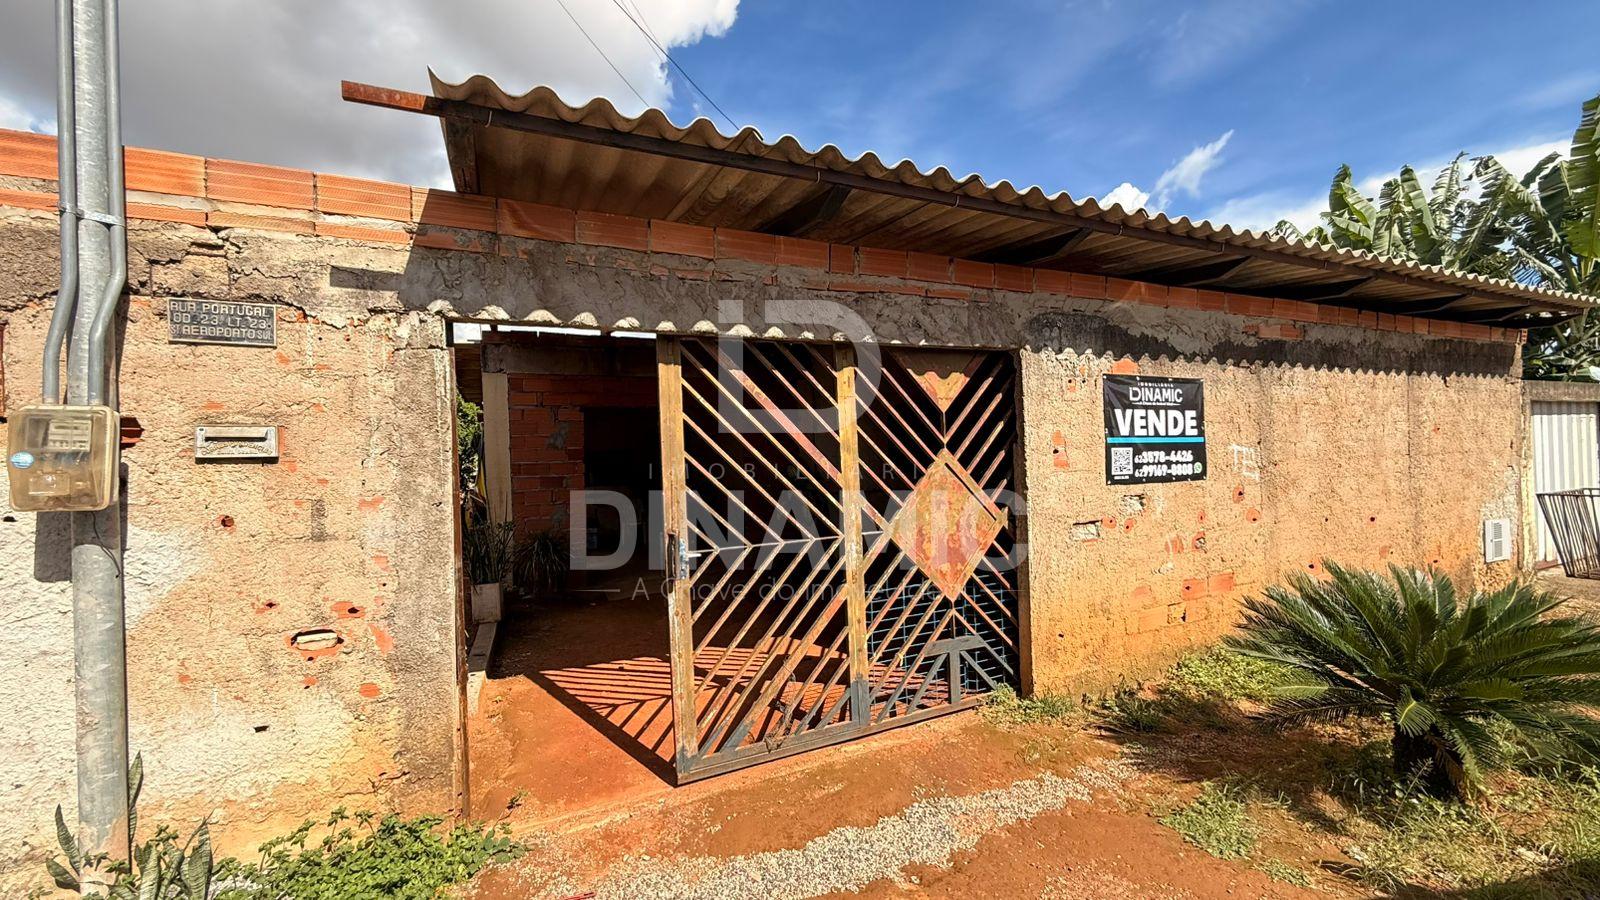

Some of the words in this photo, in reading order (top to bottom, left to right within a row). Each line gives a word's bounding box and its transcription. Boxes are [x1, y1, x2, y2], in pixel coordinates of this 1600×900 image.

[170, 301, 196, 312] RUA
[202, 303, 270, 318] PORTUGAL
[182, 325, 255, 338] AEROPORTO
[1129, 386, 1183, 402] DINAMIC
[1114, 409, 1199, 436] VENDE
